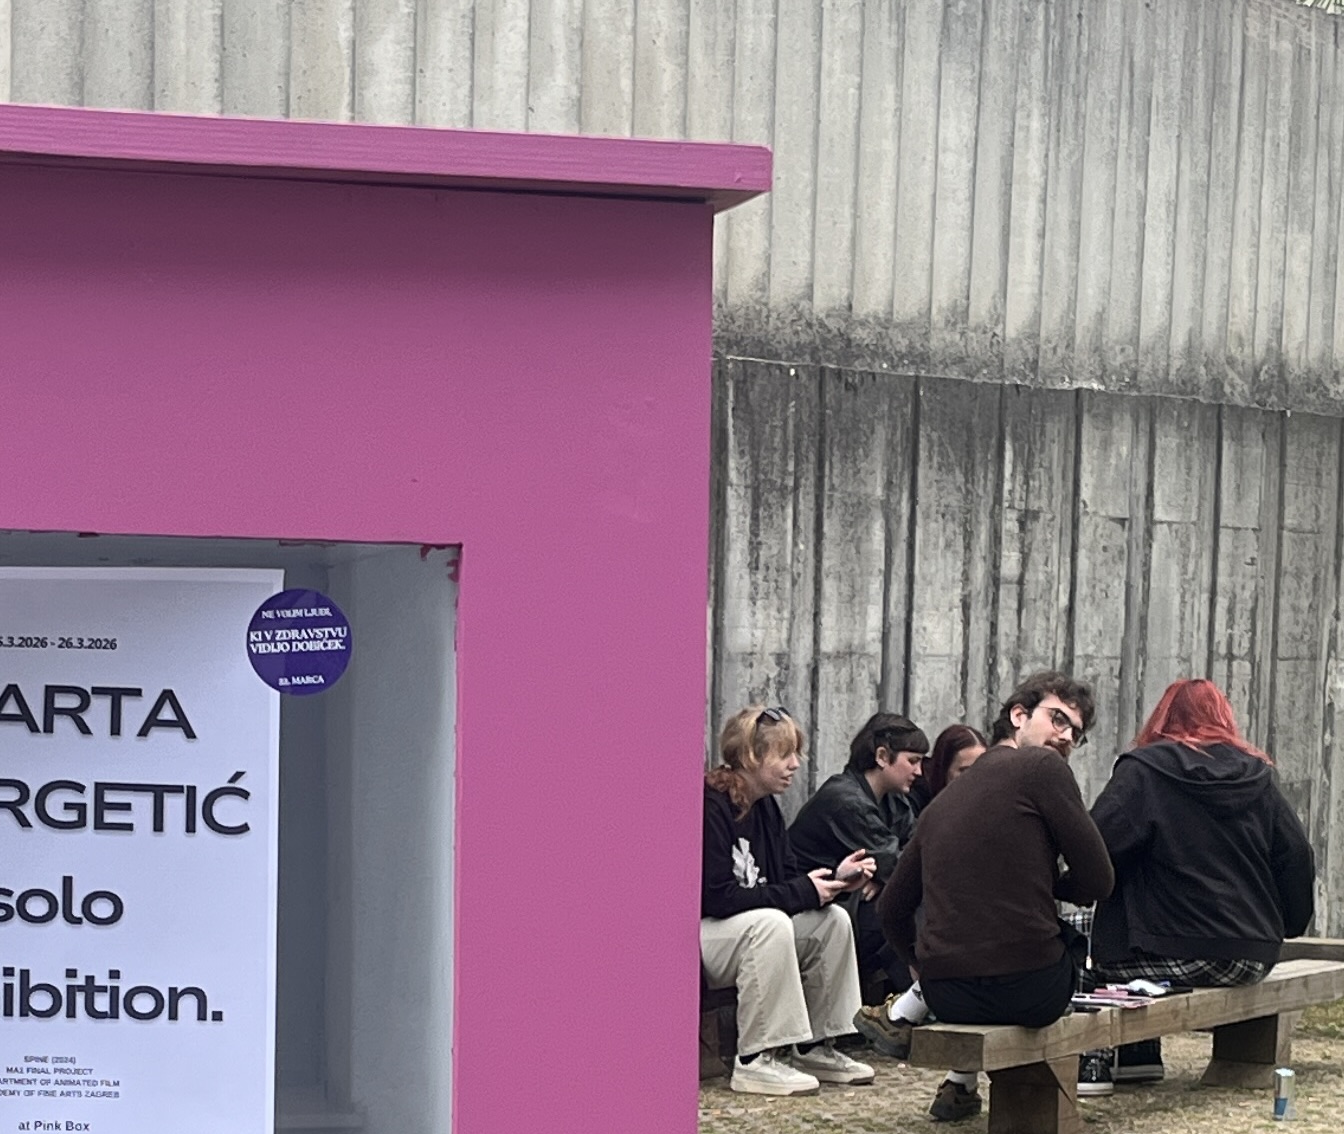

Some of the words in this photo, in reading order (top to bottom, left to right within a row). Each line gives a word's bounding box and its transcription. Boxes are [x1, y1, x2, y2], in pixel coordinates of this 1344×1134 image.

[250, 630, 262, 642] KI
[264, 630, 272, 641] V
[275, 626, 347, 641] ZDRAVSTVU
[57, 637, 118, 650] 26.3.2026
[250, 642, 291, 654] VIDIJO
[291, 638, 346, 652] DOBIČEK.
[292, 675, 325, 685] MARCA
[24, 1055, 48, 1063] SPINE
[40, 1078, 51, 1086] OF
[54, 1079, 98, 1087] ANIMATED
[59, 1090, 82, 1098] ARTS
[18, 1121, 31, 1131] at
[34, 1121, 61, 1132] Pink
[65, 1121, 90, 1132] Box
